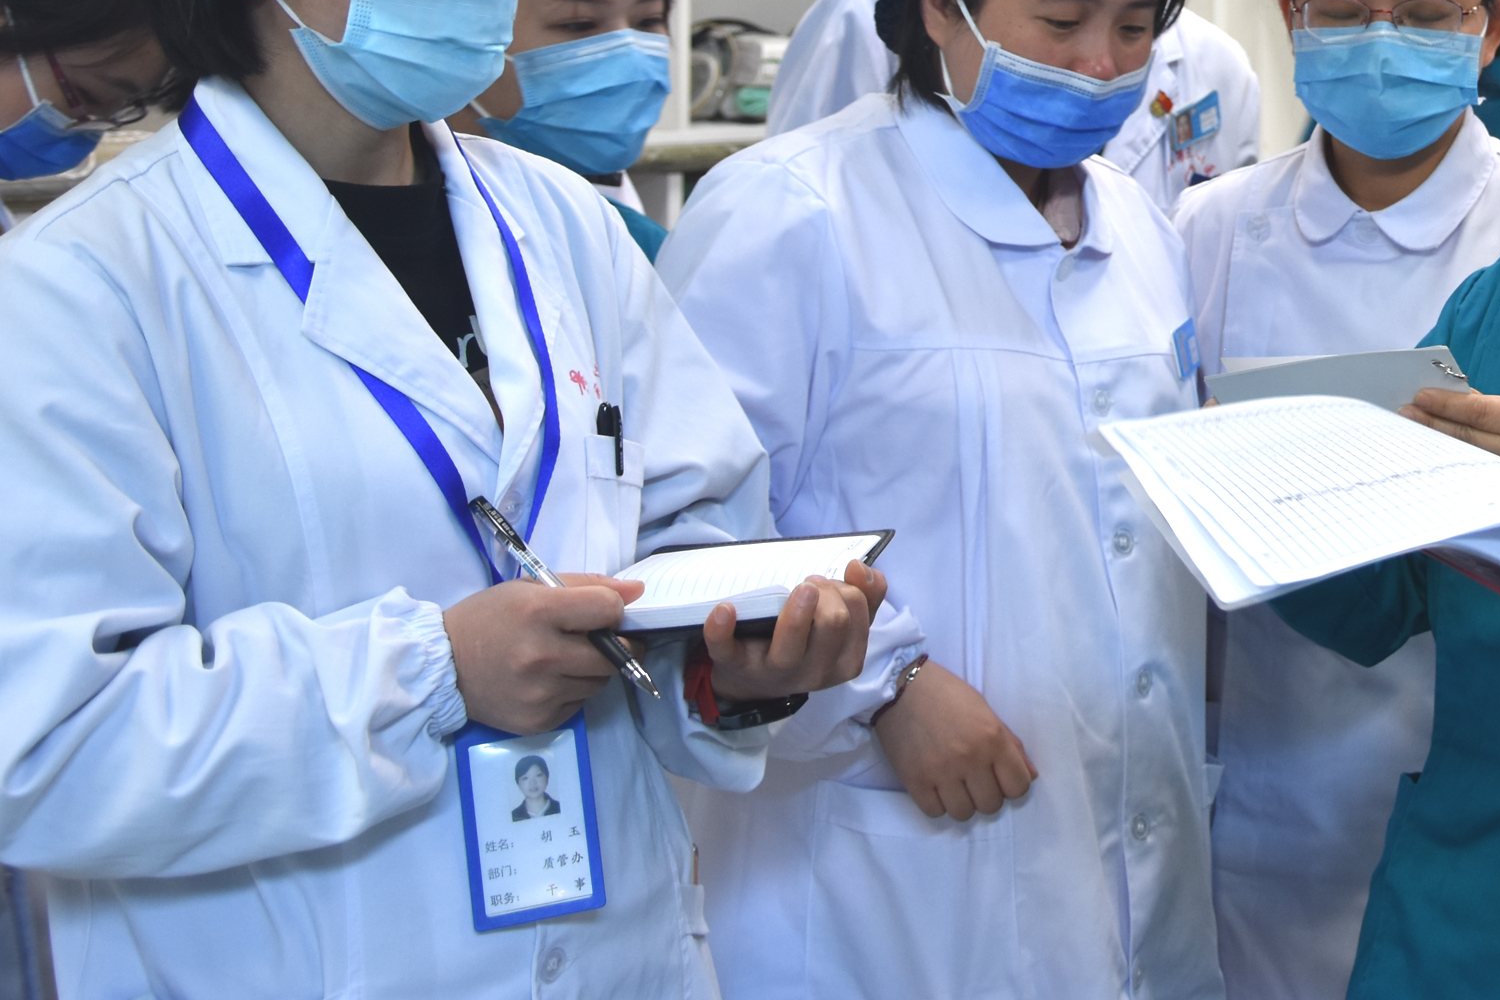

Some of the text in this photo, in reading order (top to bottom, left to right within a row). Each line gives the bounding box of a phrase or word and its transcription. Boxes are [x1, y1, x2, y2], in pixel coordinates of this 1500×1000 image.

[485, 838, 514, 853] 姓名：
[488, 851, 584, 880] 部门： 质管办
[490, 892, 520, 907] 职务：
